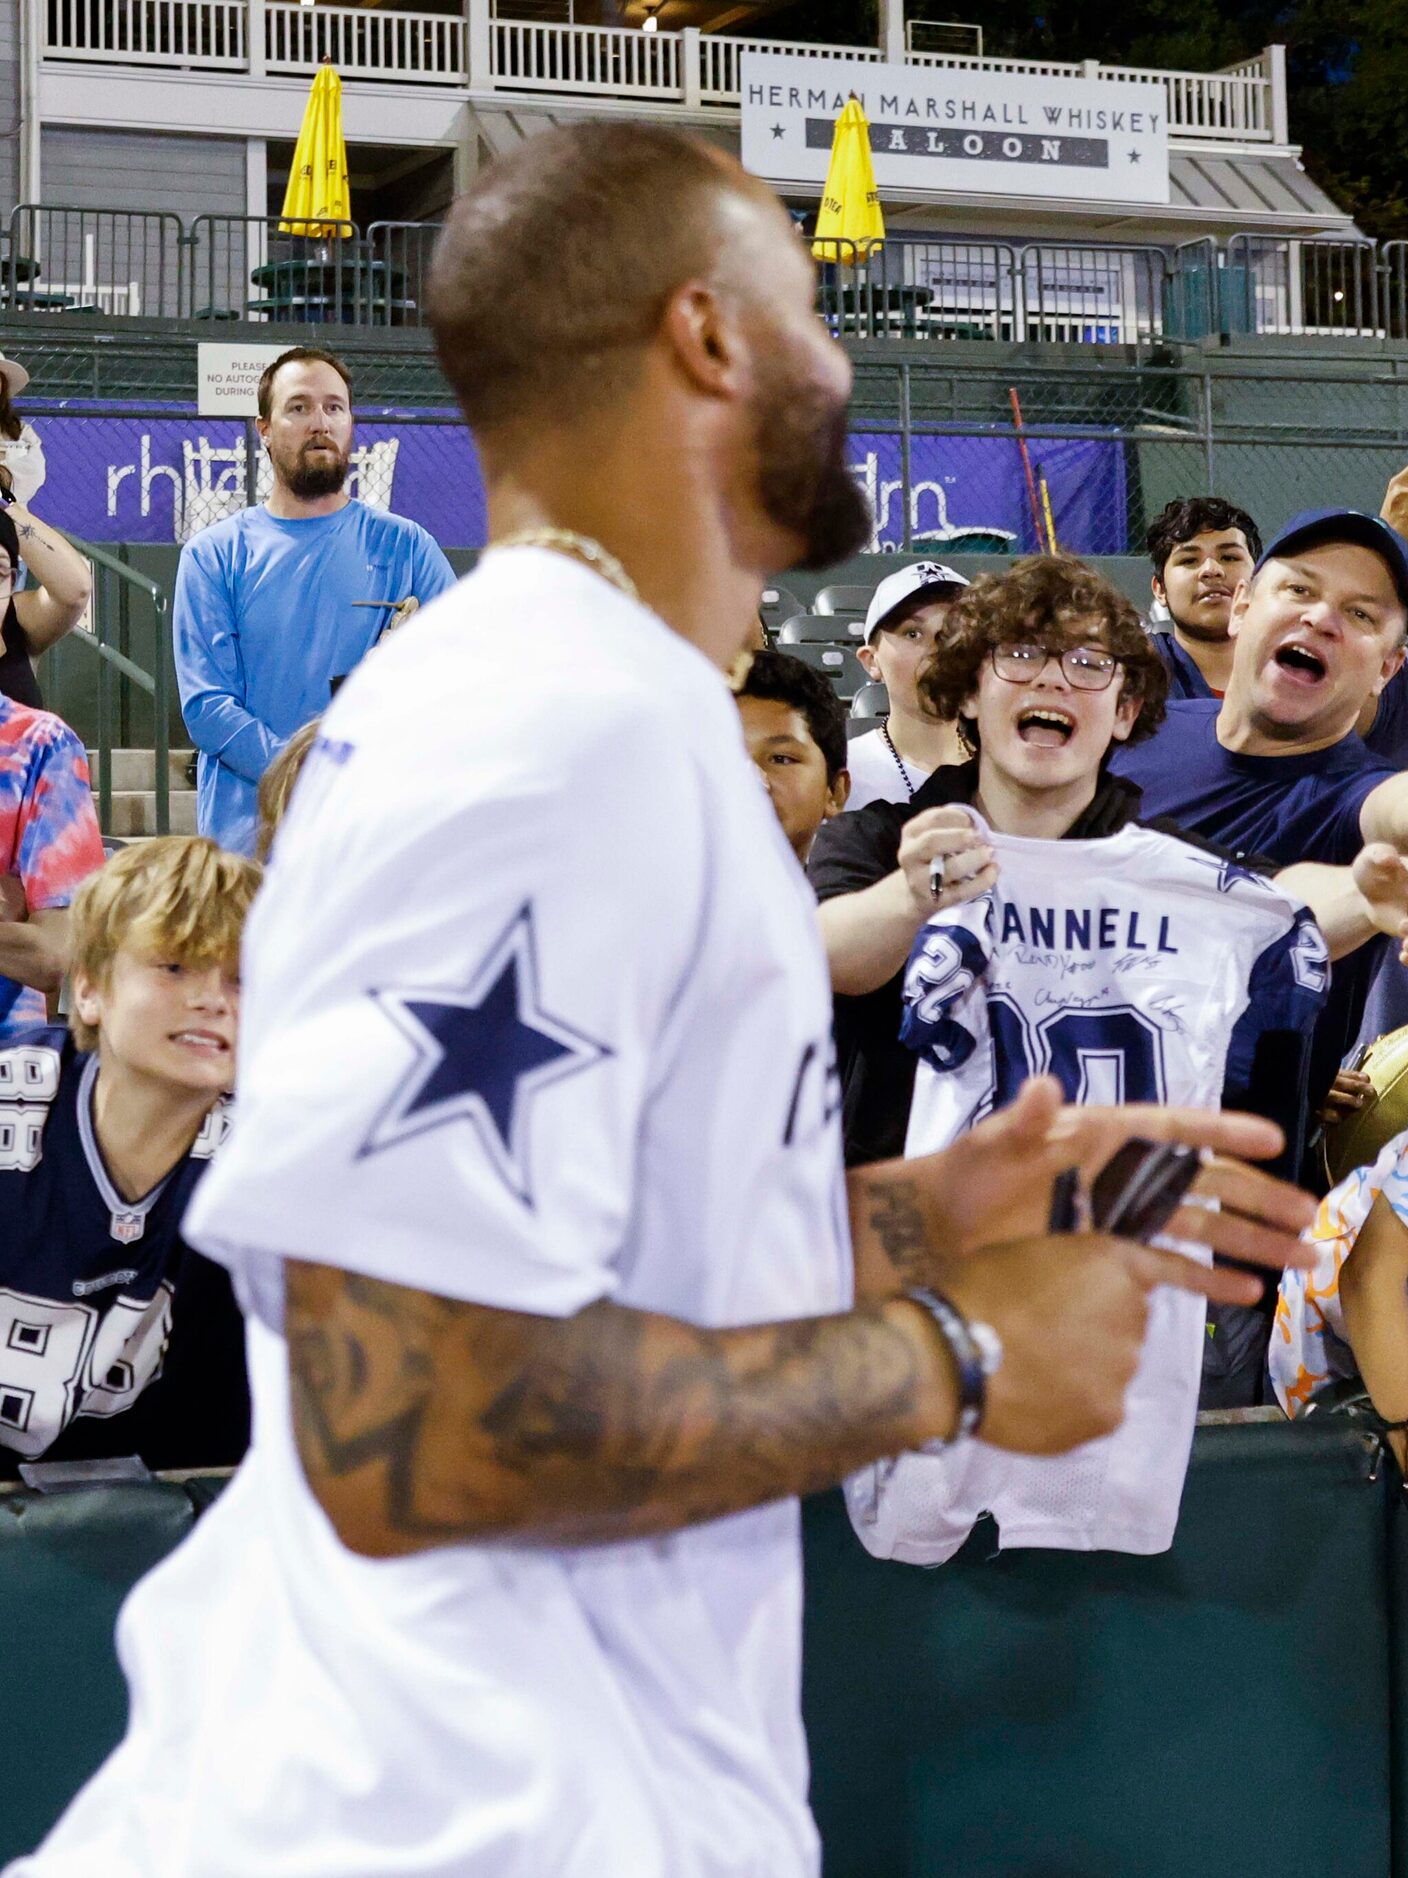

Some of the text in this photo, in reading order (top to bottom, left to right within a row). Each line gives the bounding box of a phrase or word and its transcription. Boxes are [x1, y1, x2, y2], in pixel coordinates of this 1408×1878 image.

[880, 94, 1028, 126] MARSHALL
[1042, 105, 1160, 134] WHISKEY
[887, 128, 1061, 162] ALOON
[231, 361, 267, 371] PLEASE
[207, 374, 261, 384] NO AUTOG
[215, 387, 255, 396] DURING
[1001, 902, 1179, 955] ANNELL
